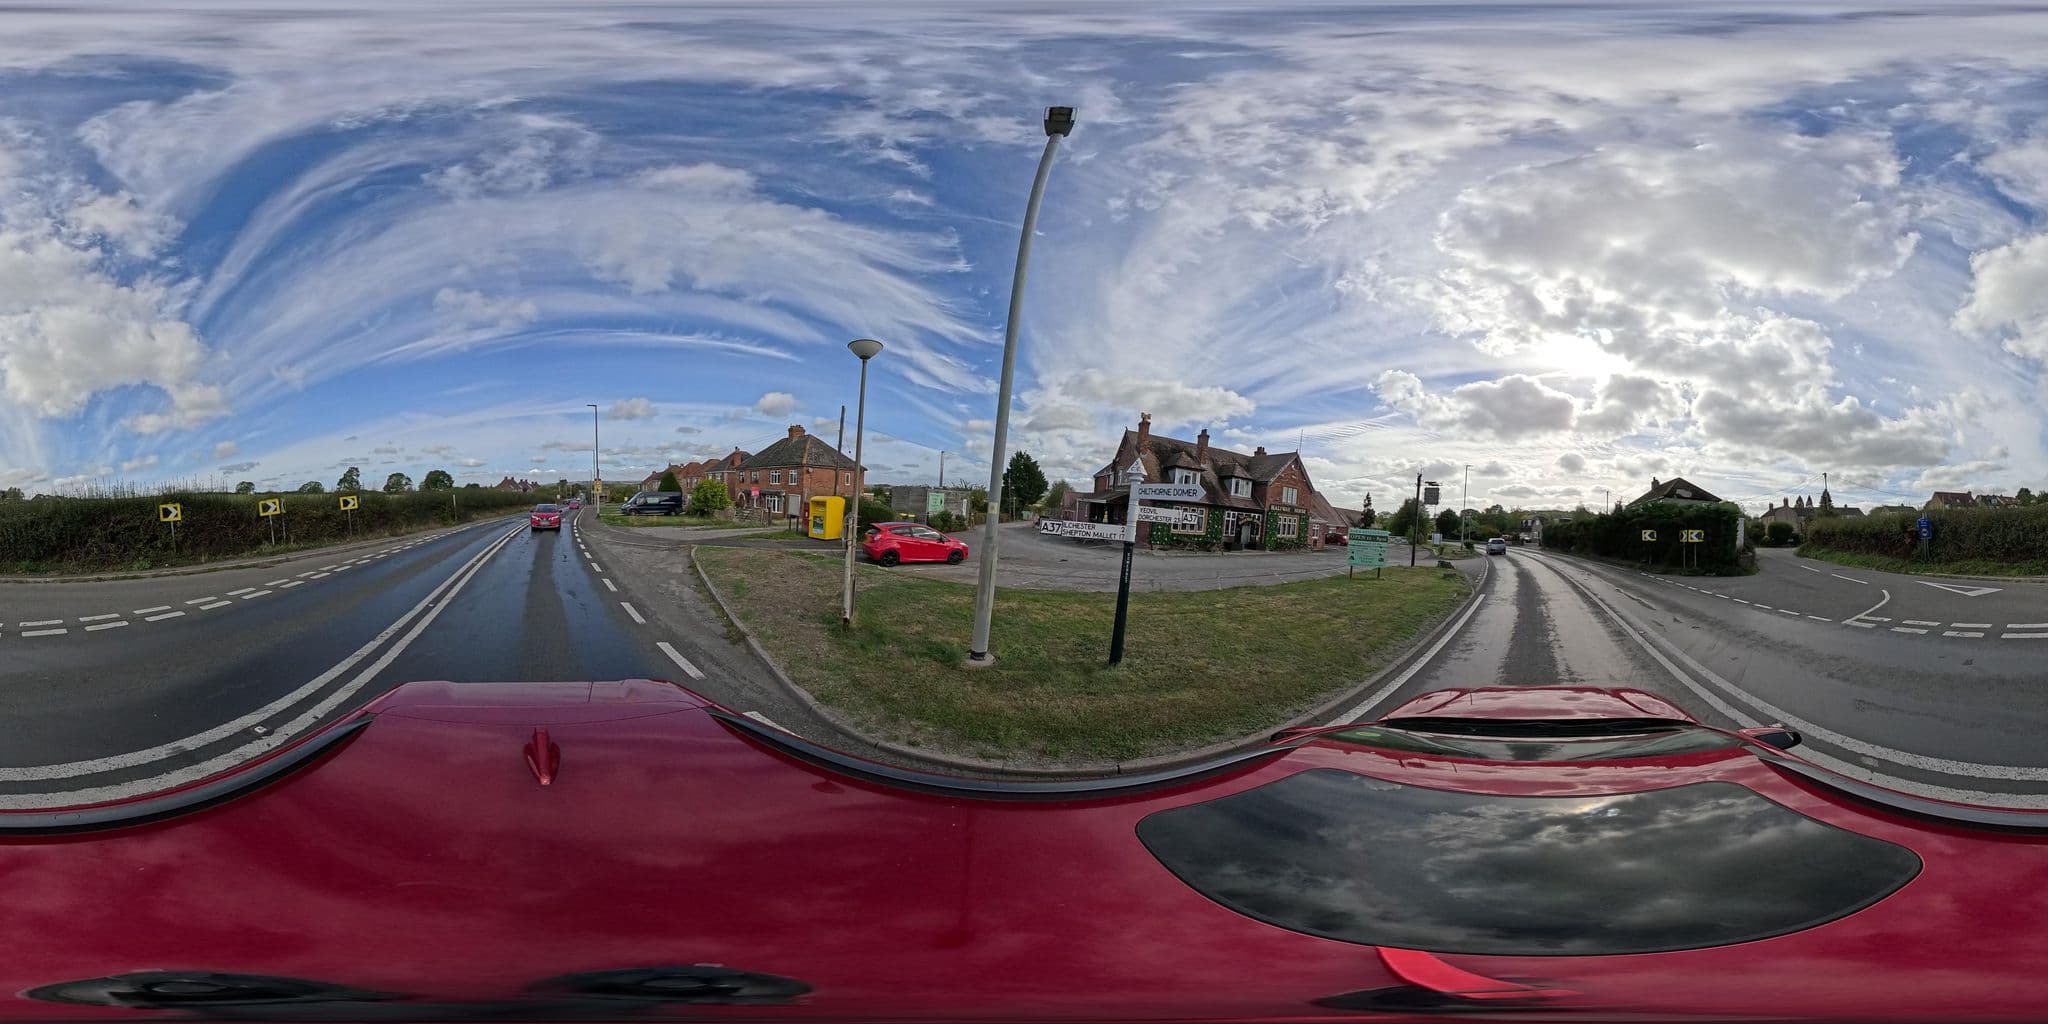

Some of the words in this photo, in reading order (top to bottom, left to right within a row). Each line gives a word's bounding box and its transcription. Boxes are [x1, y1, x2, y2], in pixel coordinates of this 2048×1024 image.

[1138, 487, 1172, 497] CHILTHORNE
[1173, 488, 1198, 497] DOMER
[1138, 514, 1172, 522] DORCHESTER
[1183, 514, 1198, 523] A37
[1042, 522, 1062, 533] A37
[1062, 522, 1096, 530] ILCHESTER
[1062, 529, 1091, 537] SHEPTON
[1093, 531, 1117, 539] MALLET
